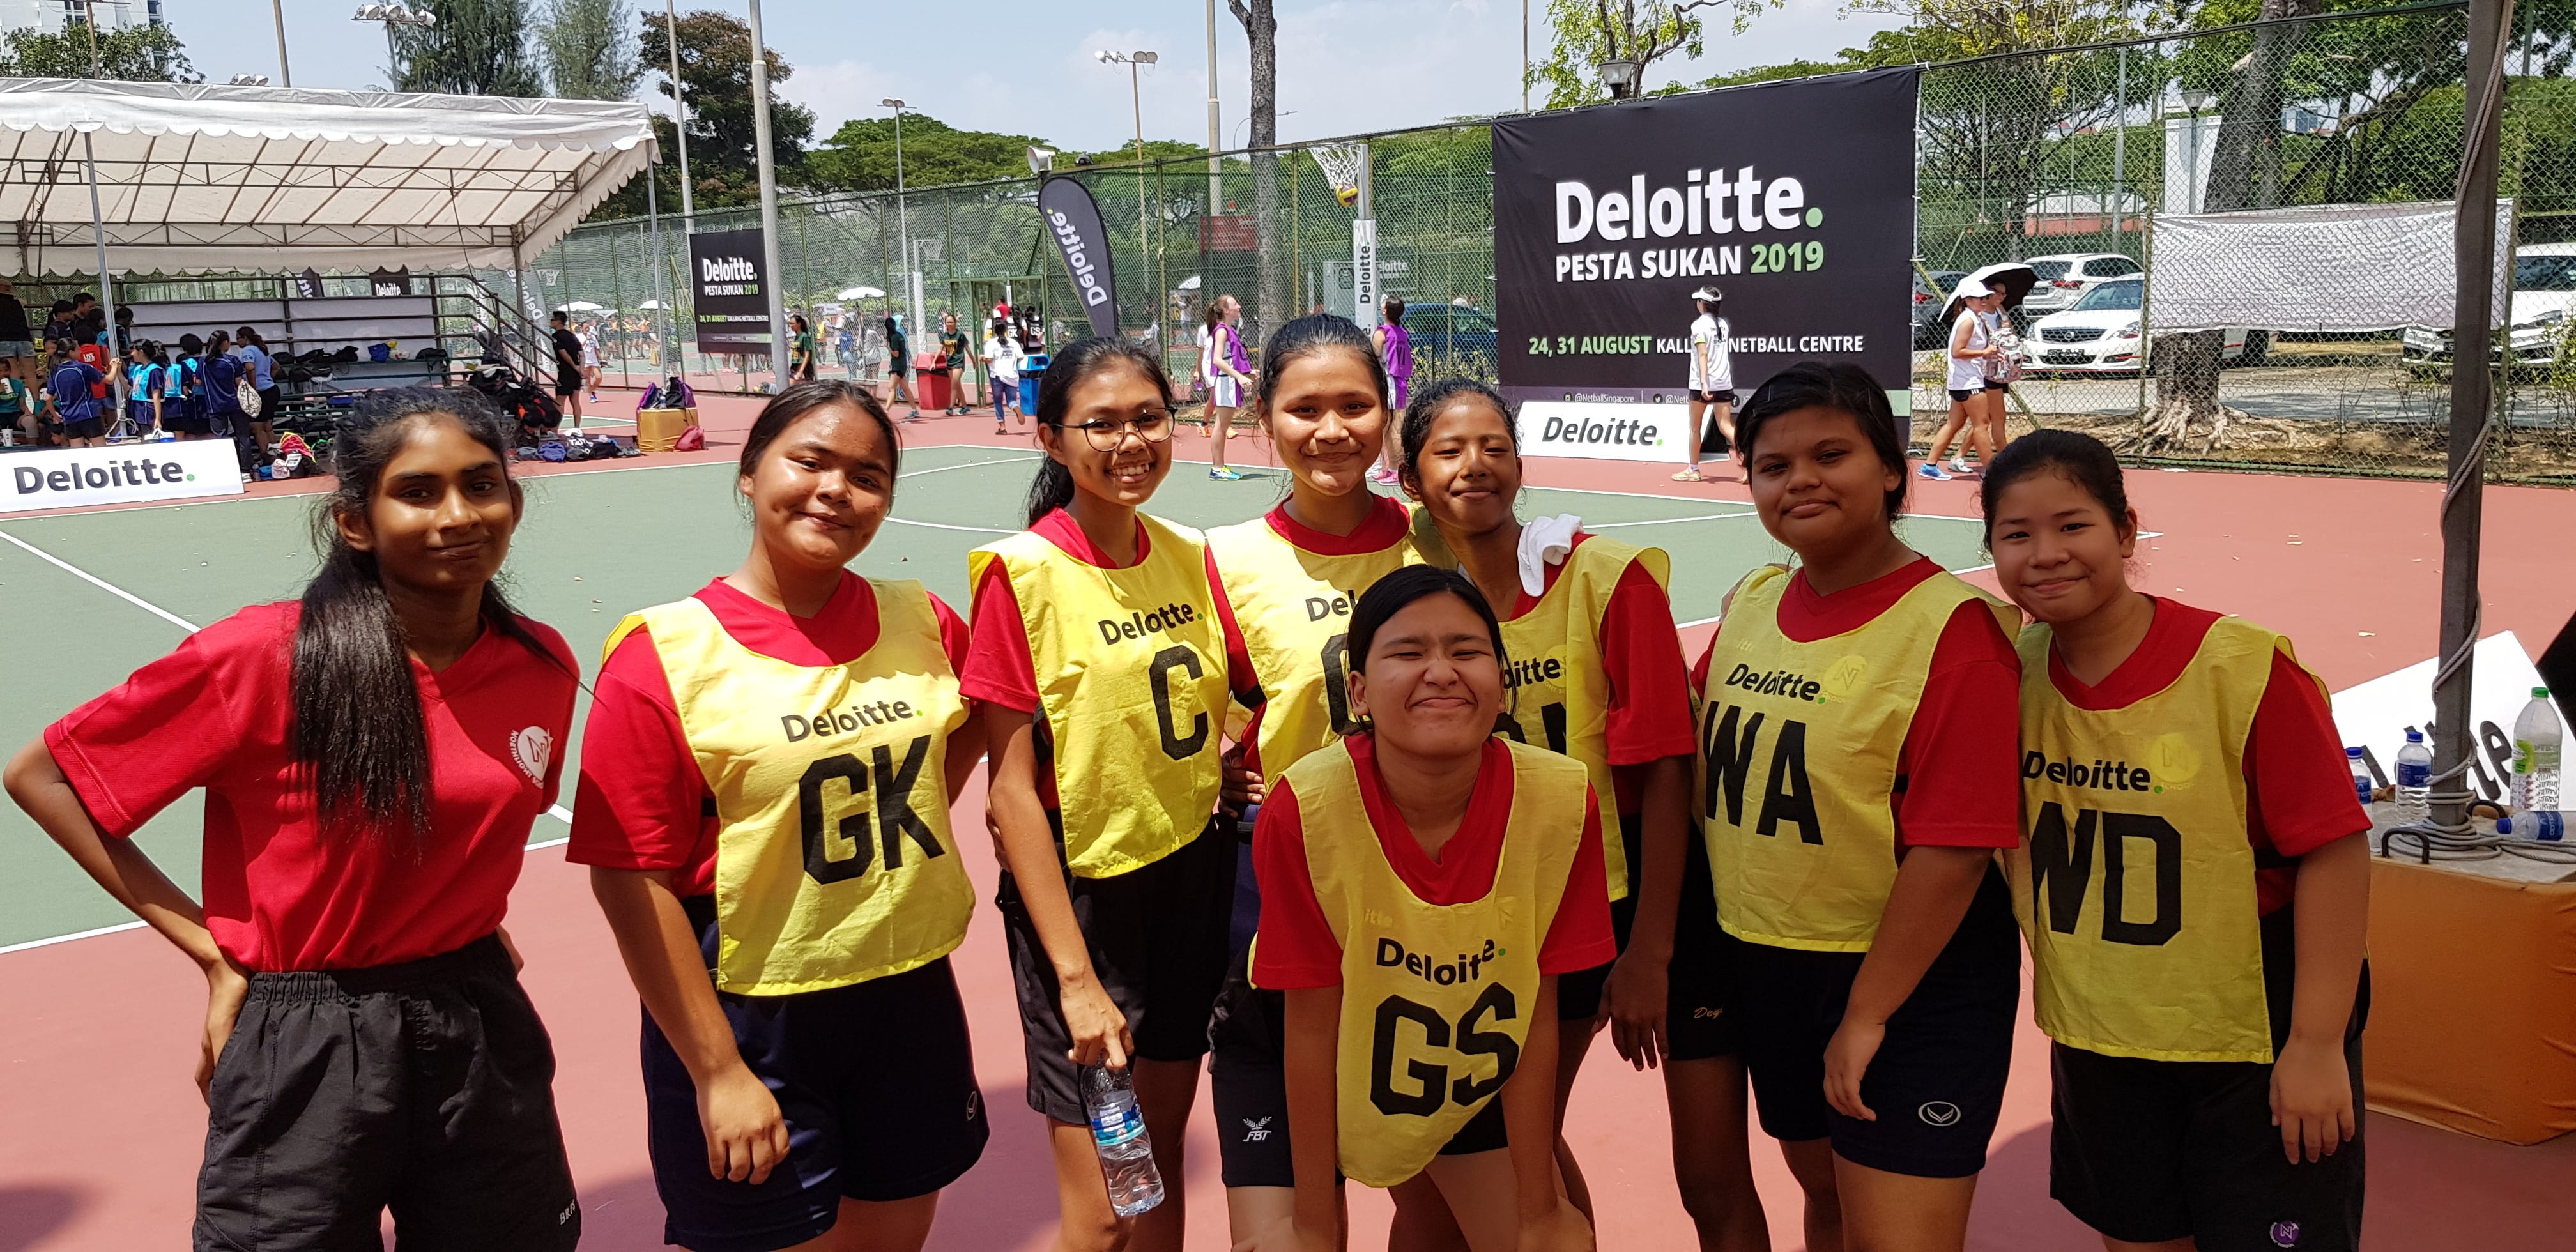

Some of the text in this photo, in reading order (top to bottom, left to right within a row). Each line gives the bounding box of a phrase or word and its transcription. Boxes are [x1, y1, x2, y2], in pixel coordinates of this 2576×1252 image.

[1556, 165, 1823, 244] Deloitte.
[702, 257, 758, 282] Deloitte.
[1360, 241, 1371, 304] Deloitte.
[1556, 240, 1824, 282] PESTA SUKAN 2019
[704, 284, 759, 296] PESTA SUKAN 2019
[1008, 328, 1018, 338] GK
[1529, 337, 1552, 358] 24,
[1556, 338, 1576, 355] 31
[1581, 336, 1652, 355] AUGUST
[1656, 339, 1692, 354] KALL
[1728, 337, 1795, 353] NETBALL
[1799, 335, 1864, 353] CENTRE
[1542, 416, 1664, 447] Deloitte.
[14, 457, 195, 495] Deloitte.
[1148, 644, 1209, 761] C
[1724, 663, 1826, 705] Deloitte.
[781, 700, 924, 743] Deloitte.
[1703, 700, 1824, 846] WA
[2023, 750, 2164, 794] Deloitte.
[799, 733, 946, 885] GK
[1370, 981, 1520, 1117] GS
[1242, 1129, 1272, 1142] FBT
